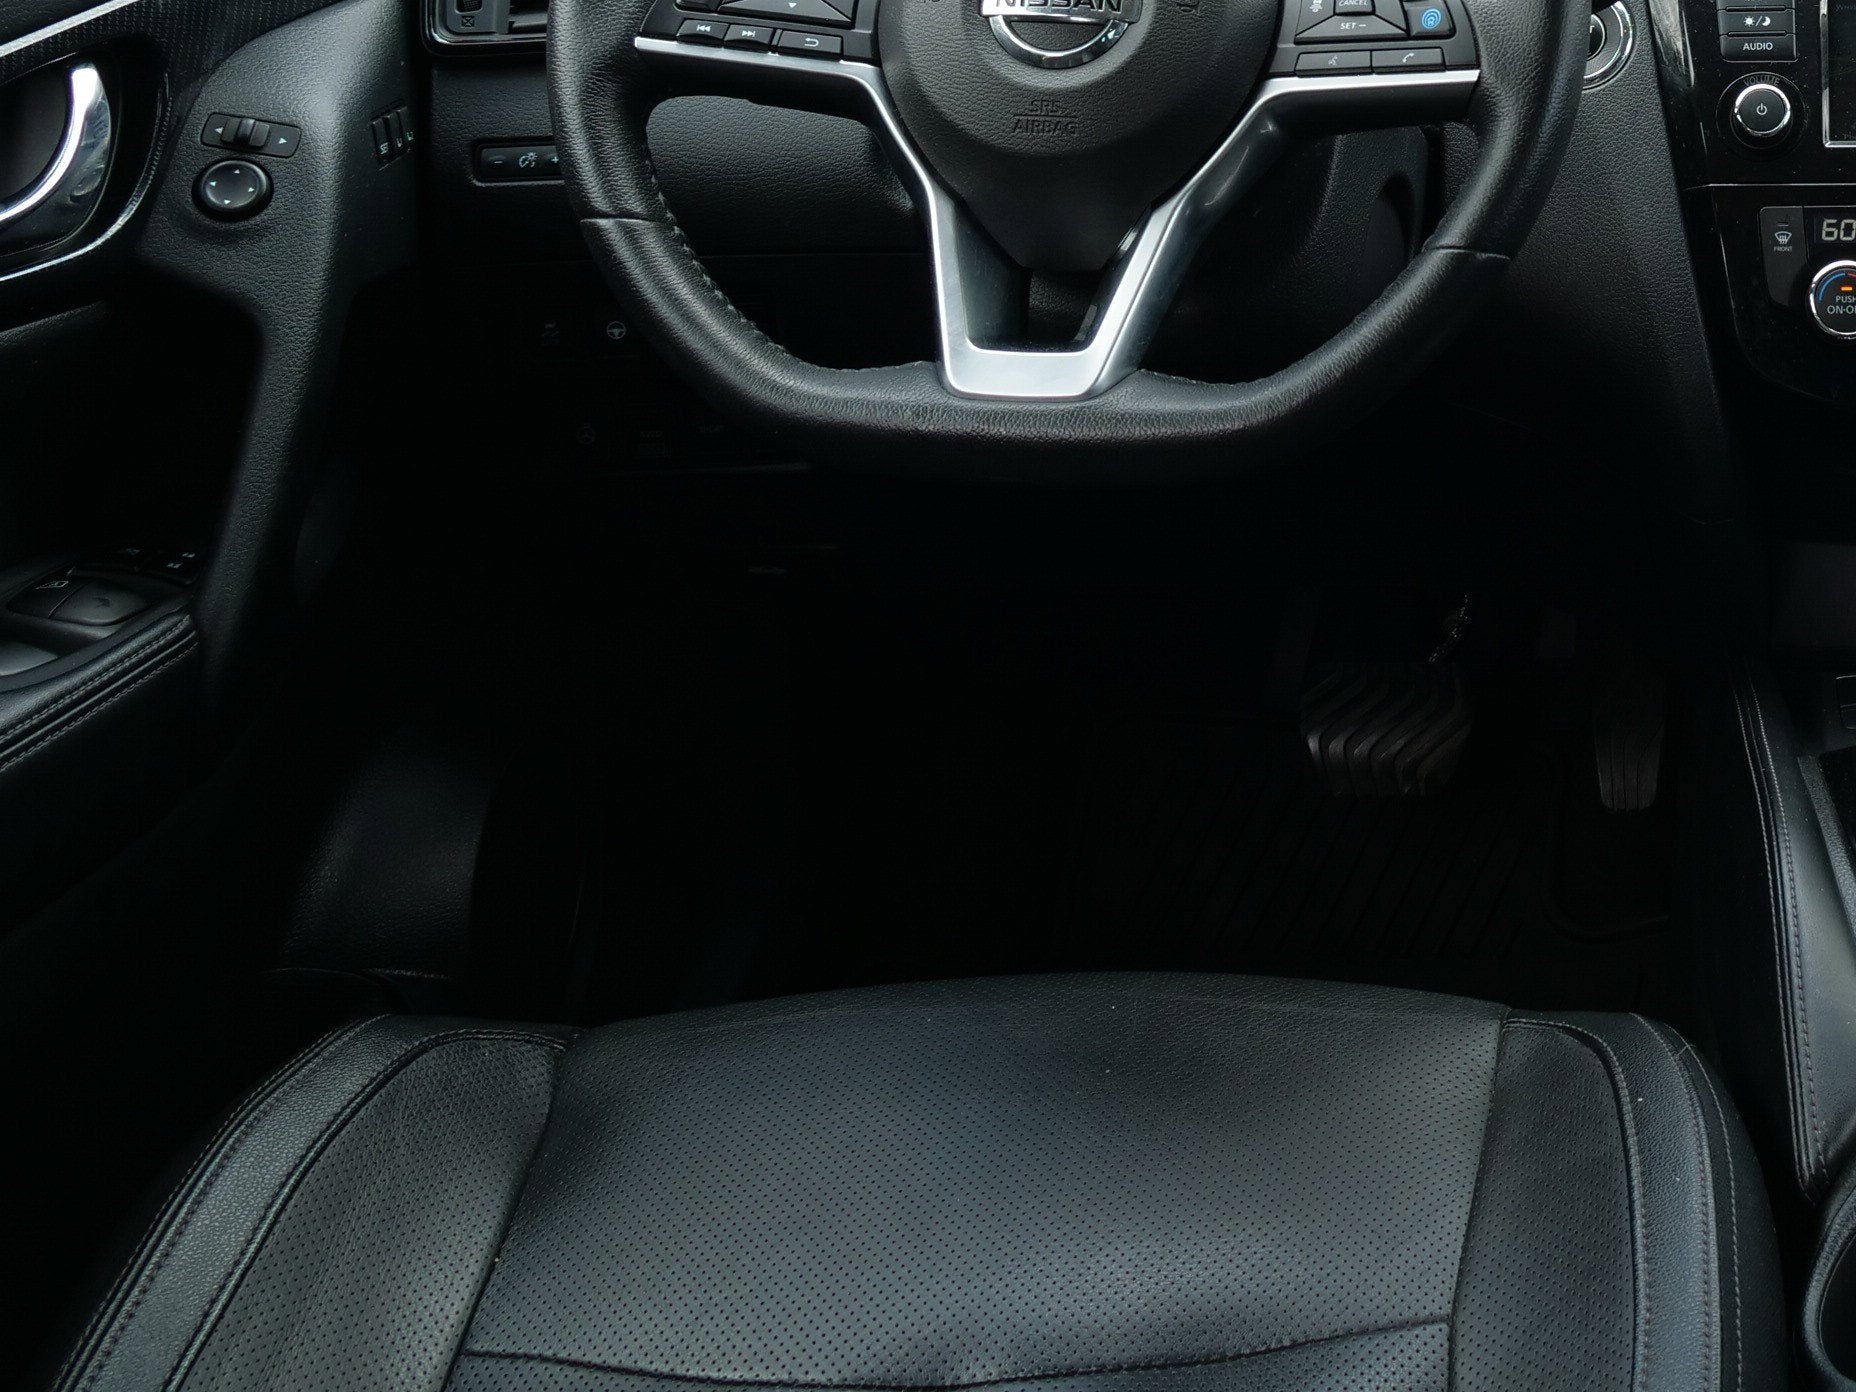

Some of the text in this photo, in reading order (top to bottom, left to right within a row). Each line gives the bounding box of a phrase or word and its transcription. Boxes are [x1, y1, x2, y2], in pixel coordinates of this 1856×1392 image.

[1340, 22, 1356, 30] SET
[1742, 41, 1774, 51] AUDIO
[1743, 74, 1781, 87] VOLUME
[1030, 99, 1062, 113] SRS
[1012, 118, 1079, 136] AIRBAG
